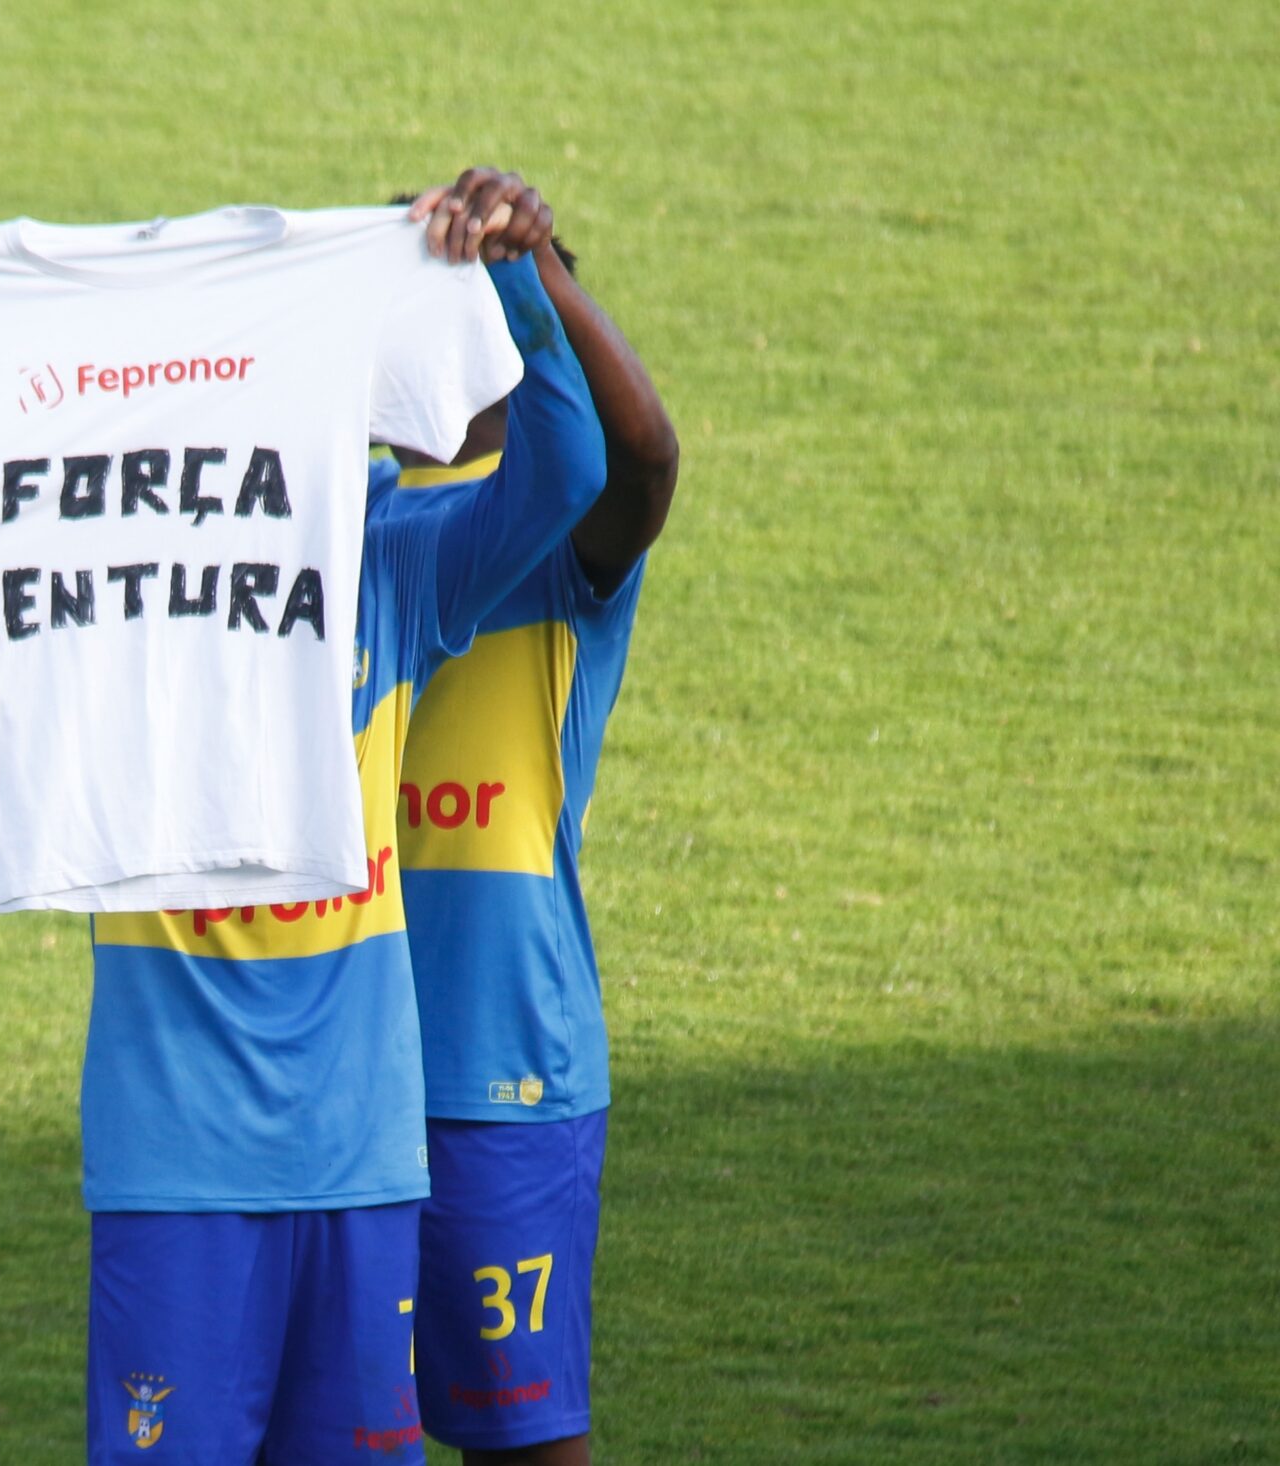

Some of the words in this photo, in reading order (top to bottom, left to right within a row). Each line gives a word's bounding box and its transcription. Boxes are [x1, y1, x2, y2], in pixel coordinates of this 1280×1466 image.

[77, 353, 254, 397] Fepronor
[2, 445, 292, 526] FORÇA
[473, 1252, 554, 1341] 37
